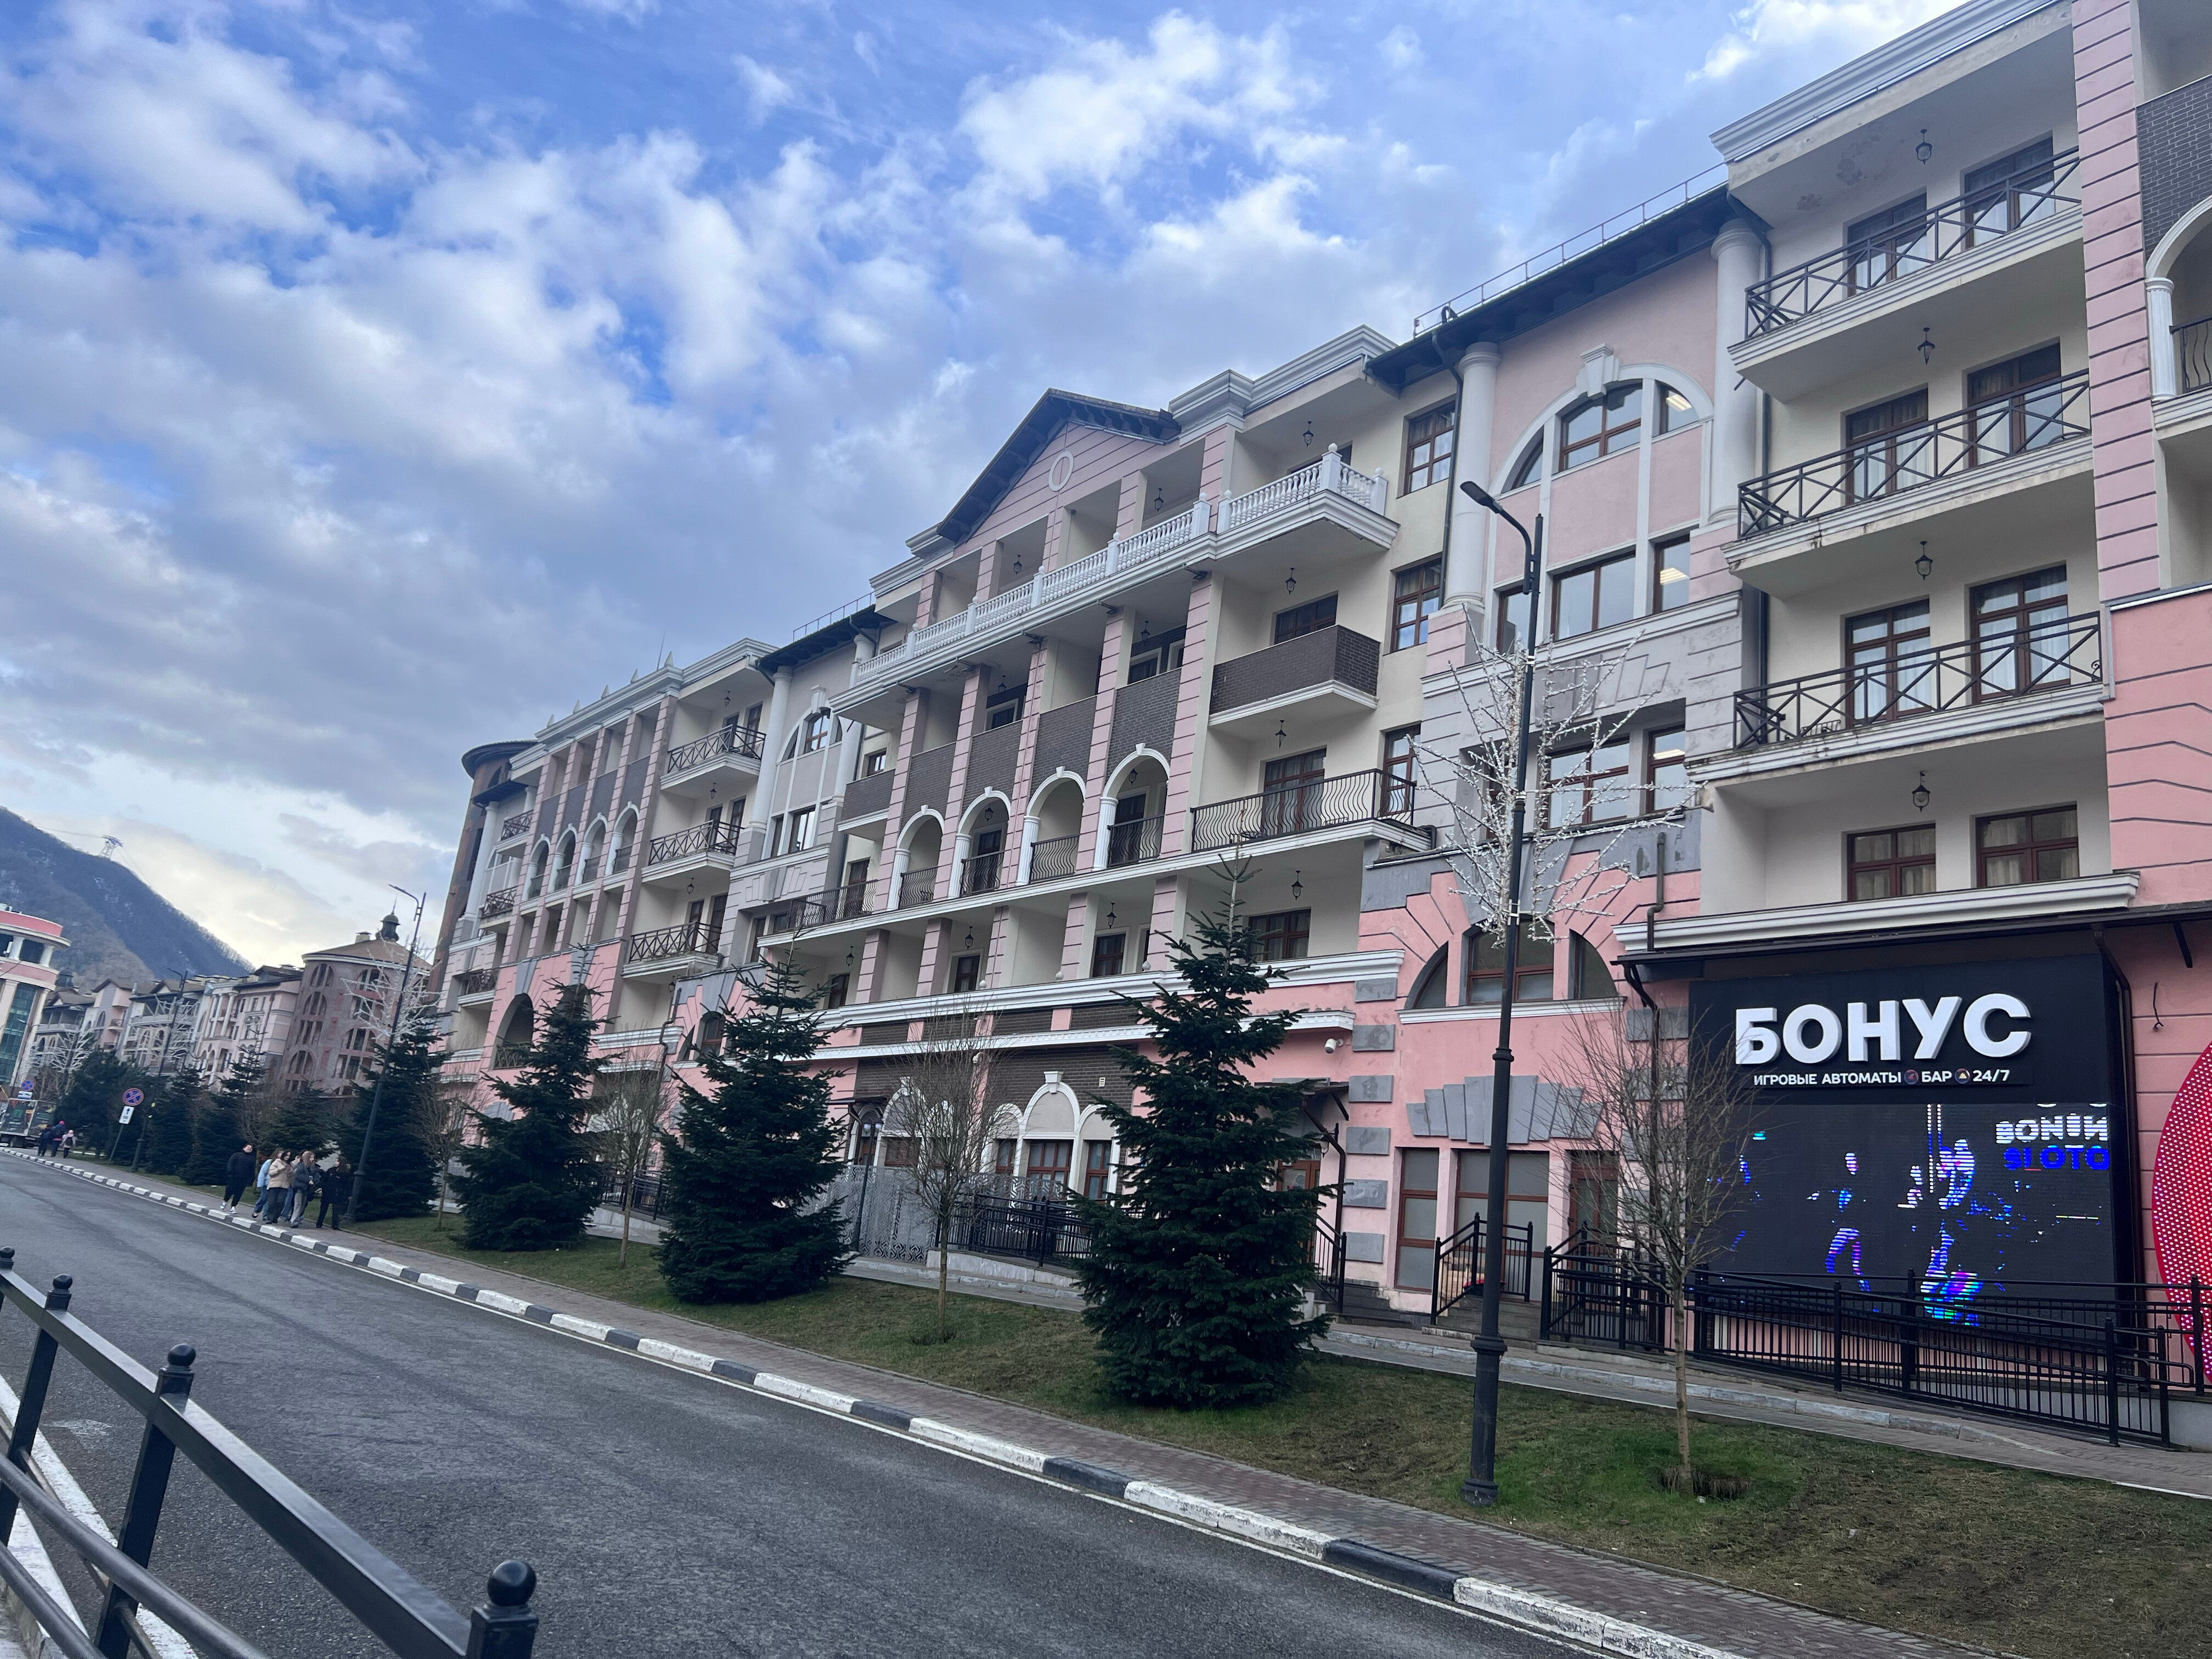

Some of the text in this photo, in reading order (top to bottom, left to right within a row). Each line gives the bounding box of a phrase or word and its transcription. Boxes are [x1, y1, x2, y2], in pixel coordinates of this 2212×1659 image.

[1736, 994, 2032, 1065] БОНУС
[1753, 1069, 2010, 1086] ИГРОВЫЕ АВТОМАТЫ БАР 24/7
